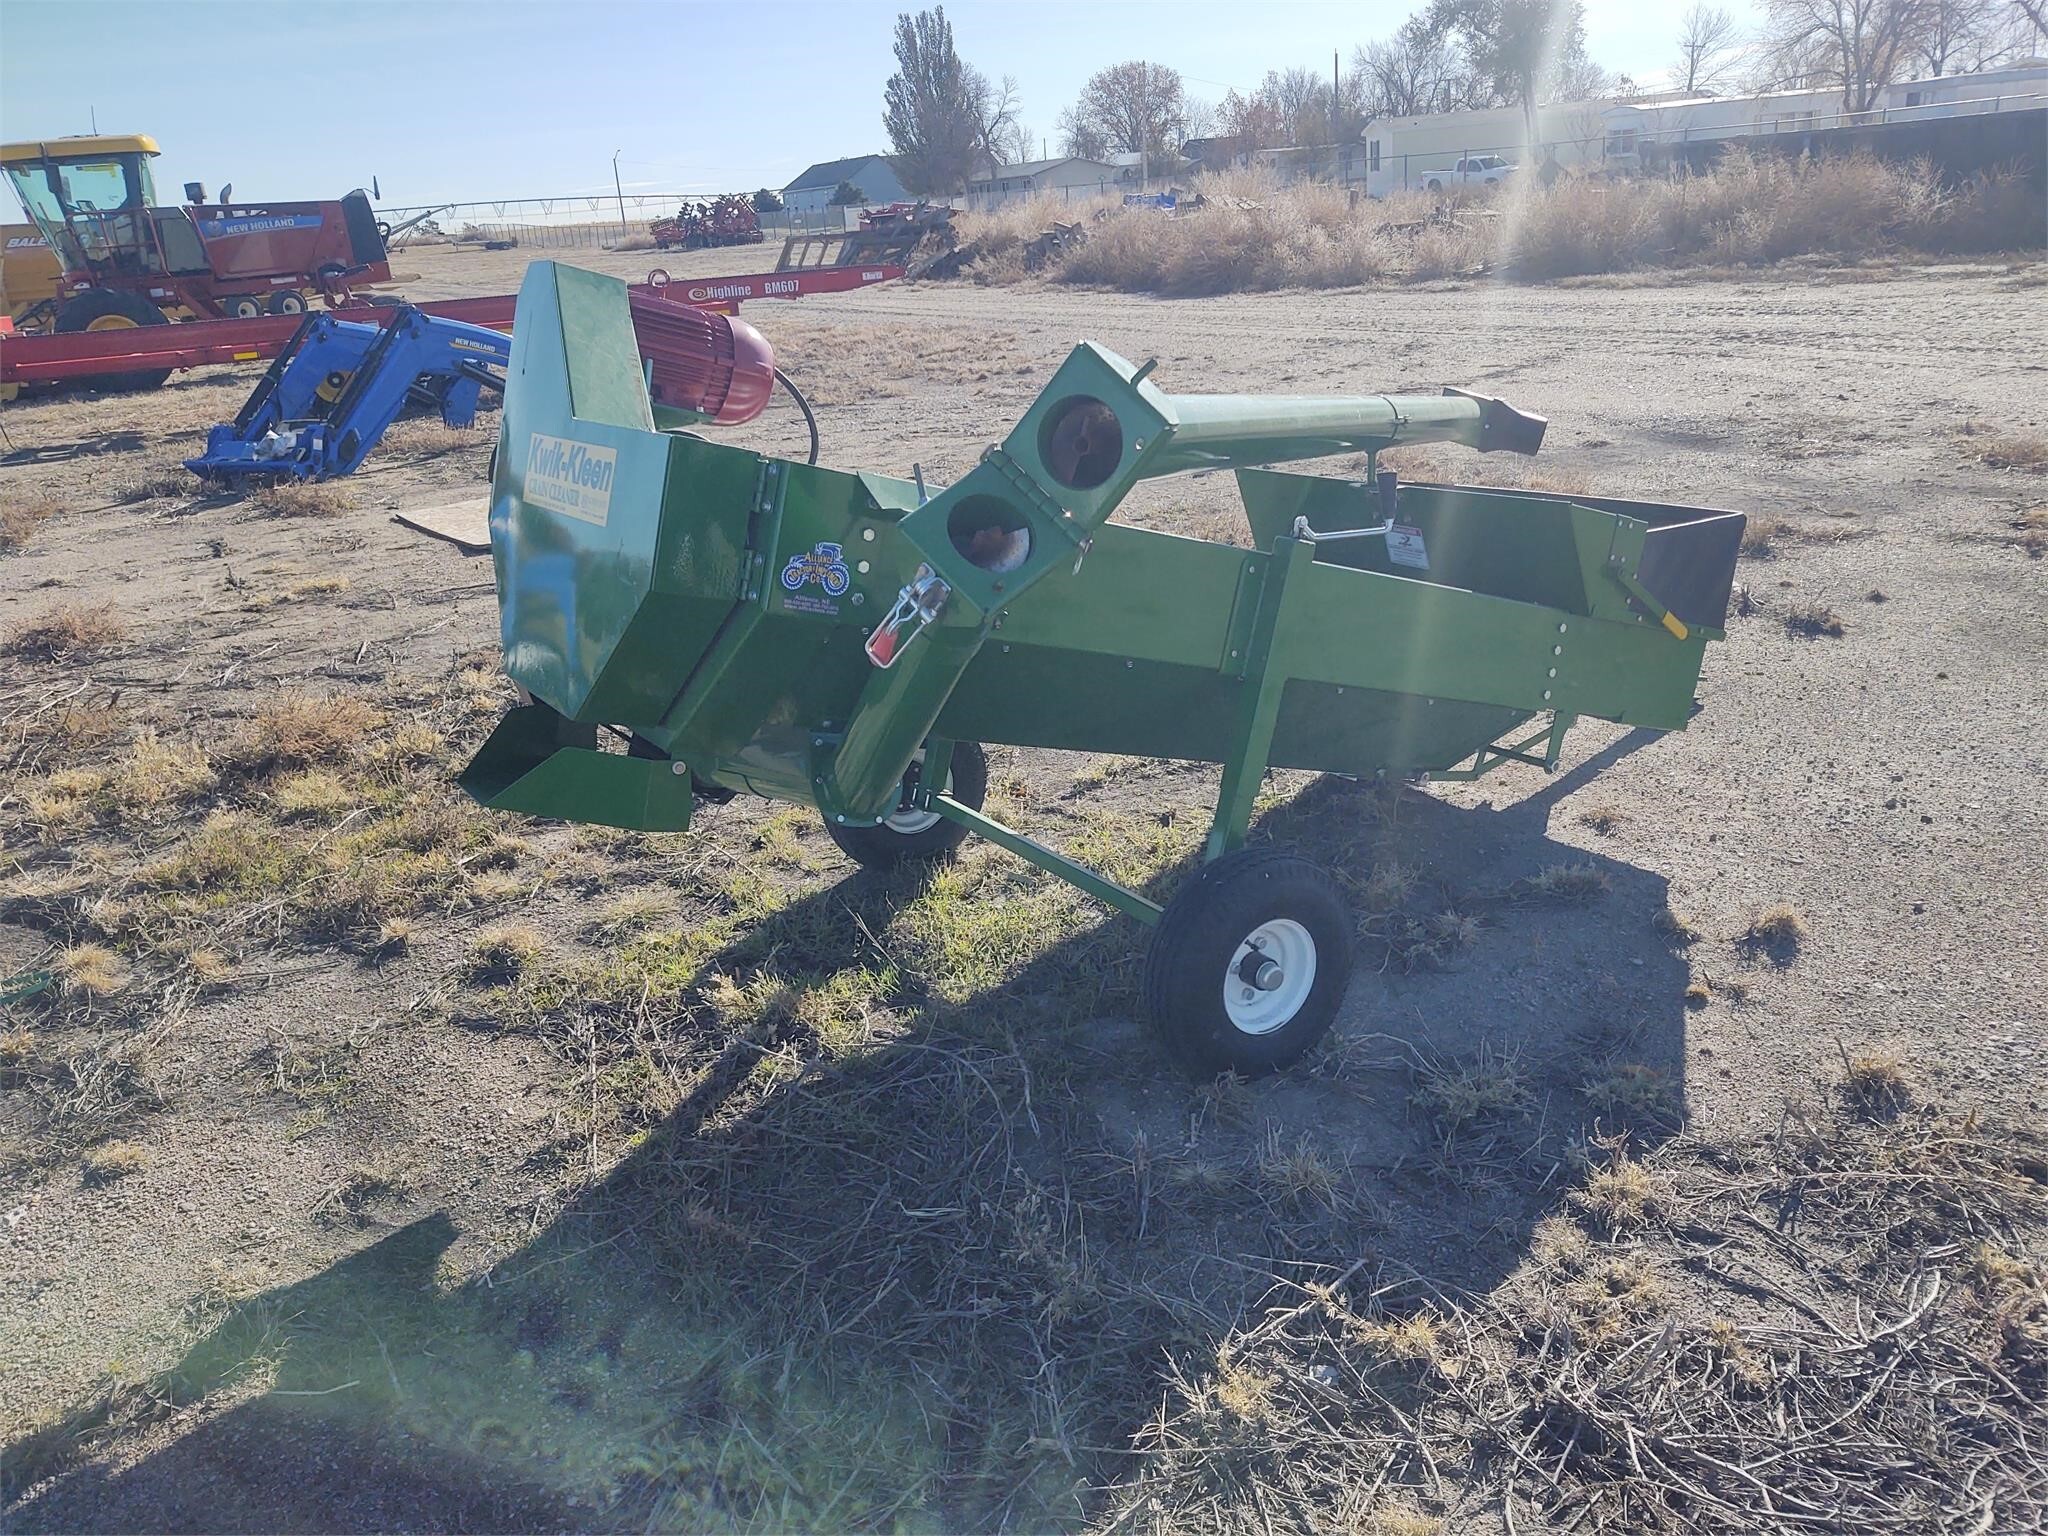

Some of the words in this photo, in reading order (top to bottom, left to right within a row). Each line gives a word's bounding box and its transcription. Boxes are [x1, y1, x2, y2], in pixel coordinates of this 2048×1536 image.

[225, 223, 249, 234] NEW
[250, 218, 295, 231] HOLLAND
[706, 284, 752, 299] Highline
[764, 279, 800, 295] BM607
[455, 337, 470, 346] NEW
[470, 340, 496, 353] HOLLAND
[528, 437, 614, 492] Kwik-Kleen
[548, 483, 580, 507] CLEANER
